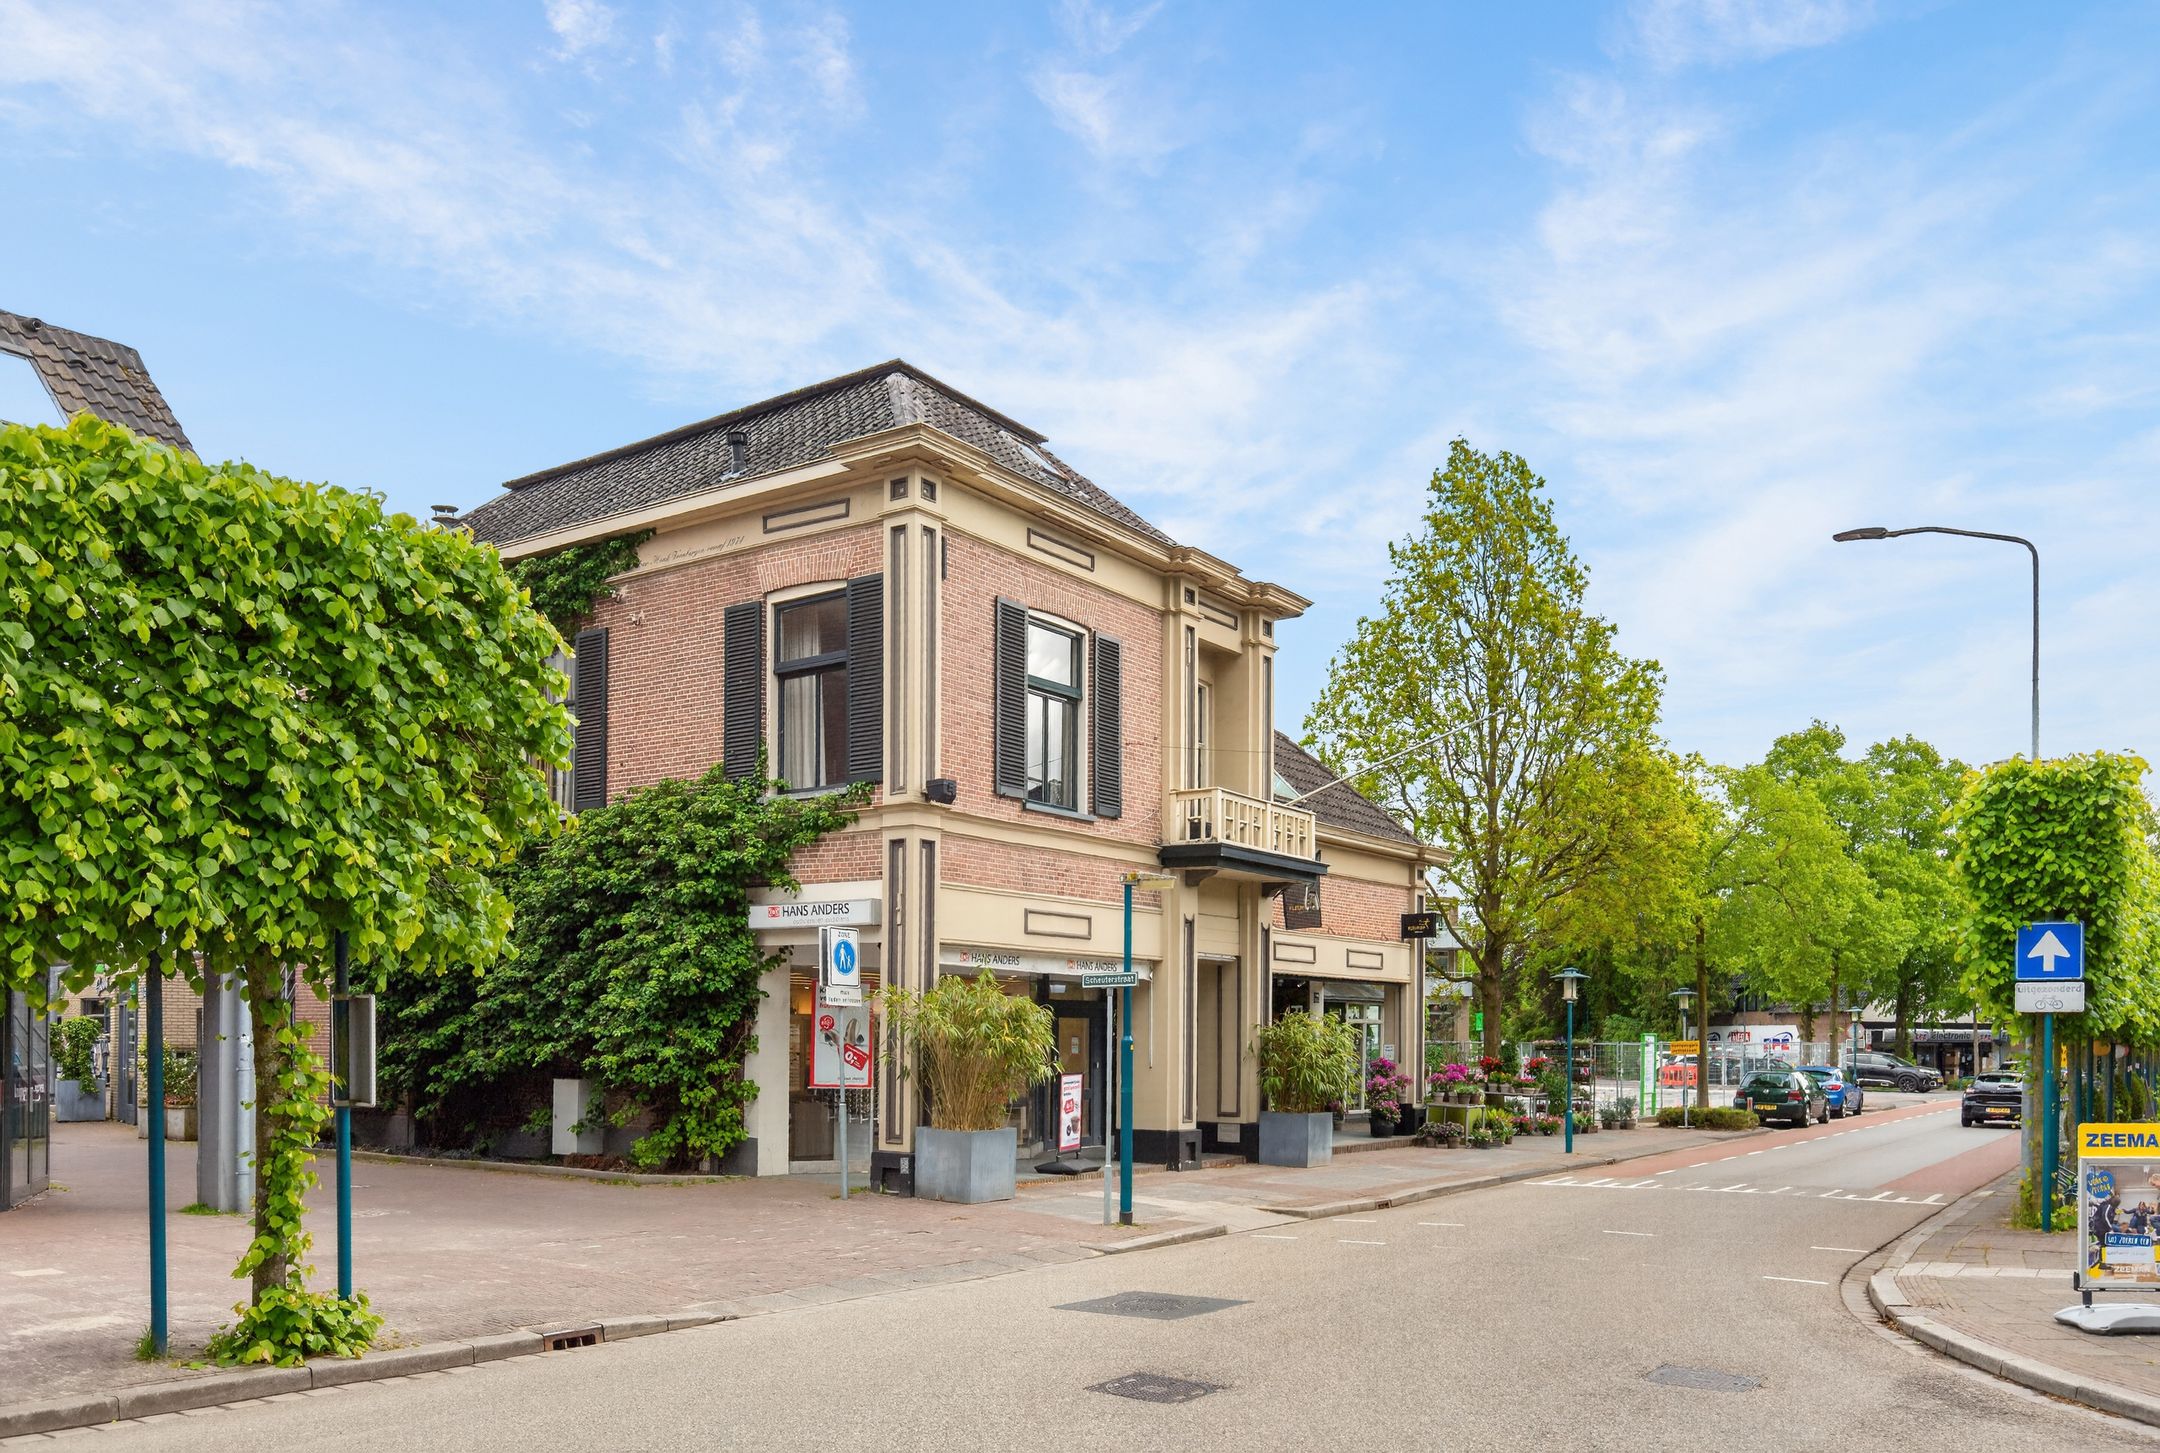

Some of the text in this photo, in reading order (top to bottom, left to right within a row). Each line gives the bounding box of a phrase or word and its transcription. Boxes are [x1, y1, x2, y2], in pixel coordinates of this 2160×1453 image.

[782, 903, 850, 917] HANS ANDERS
[971, 952, 1020, 966] HANS ANDERS
[1076, 960, 1118, 972] HANS ANDERS
[2017, 984, 2082, 995] uitgezonderd
